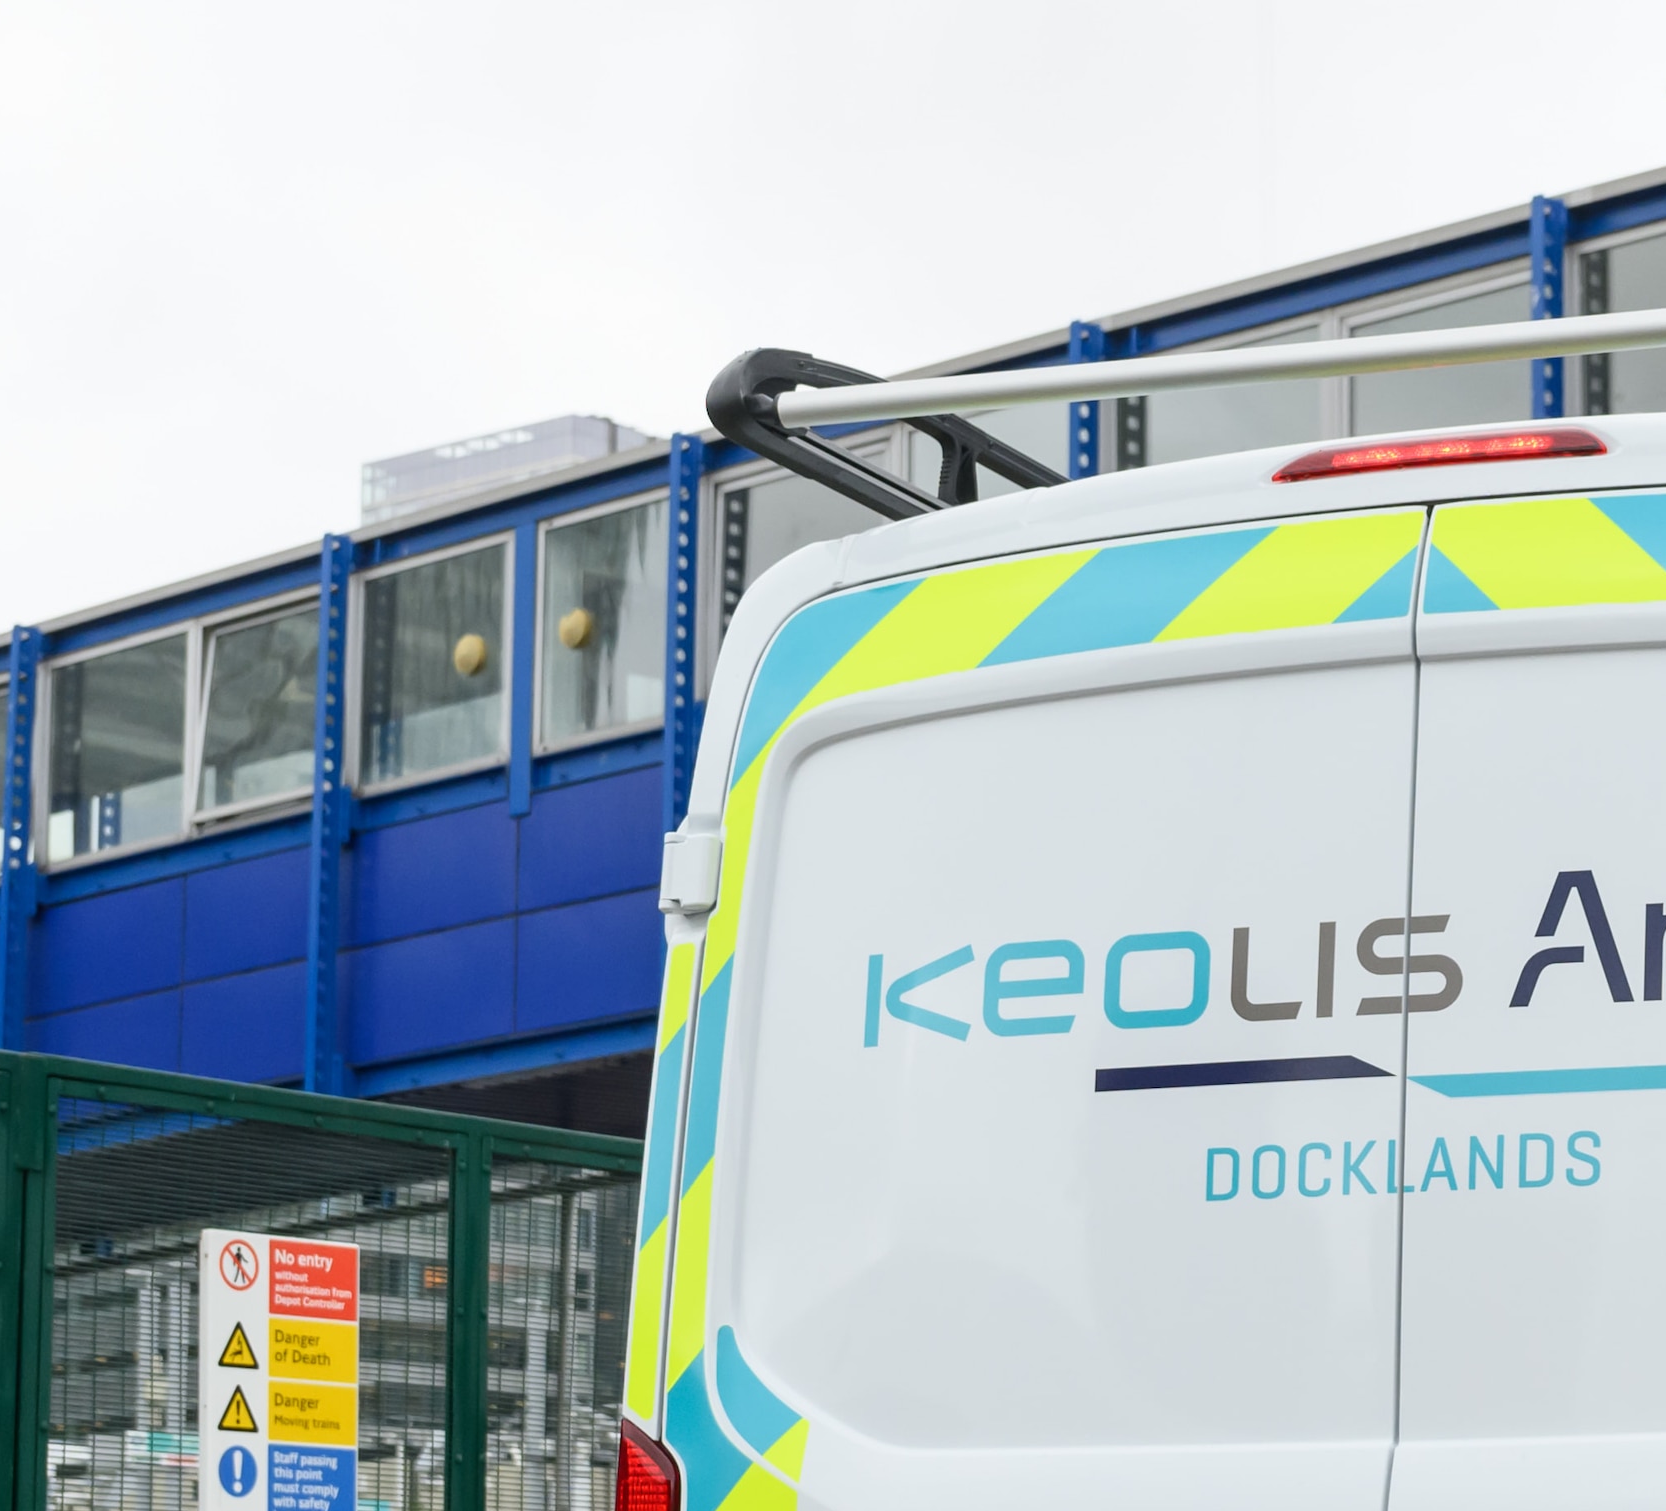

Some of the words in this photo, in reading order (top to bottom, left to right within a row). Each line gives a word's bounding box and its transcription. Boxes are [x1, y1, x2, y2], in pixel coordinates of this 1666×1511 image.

[1205, 1130, 1602, 1203] DOCKLANDS
[274, 1248, 295, 1266] No
[297, 1254, 333, 1273] entry
[274, 1271, 309, 1283] without
[274, 1283, 331, 1297] authorisation
[332, 1287, 353, 1299] from
[274, 1293, 301, 1307] Depot
[303, 1296, 345, 1310] Controller
[275, 1329, 320, 1348] Danger
[275, 1348, 287, 1362] of
[292, 1349, 331, 1366] Death
[274, 1392, 320, 1412] Danger
[274, 1415, 310, 1430] Moving
[312, 1418, 341, 1431] trains
[274, 1451, 299, 1464] Staff
[300, 1454, 338, 1471] passing
[274, 1466, 293, 1479] this
[295, 1468, 323, 1481] point
[274, 1482, 300, 1494] must
[302, 1484, 339, 1500] comply
[274, 1496, 297, 1508] with
